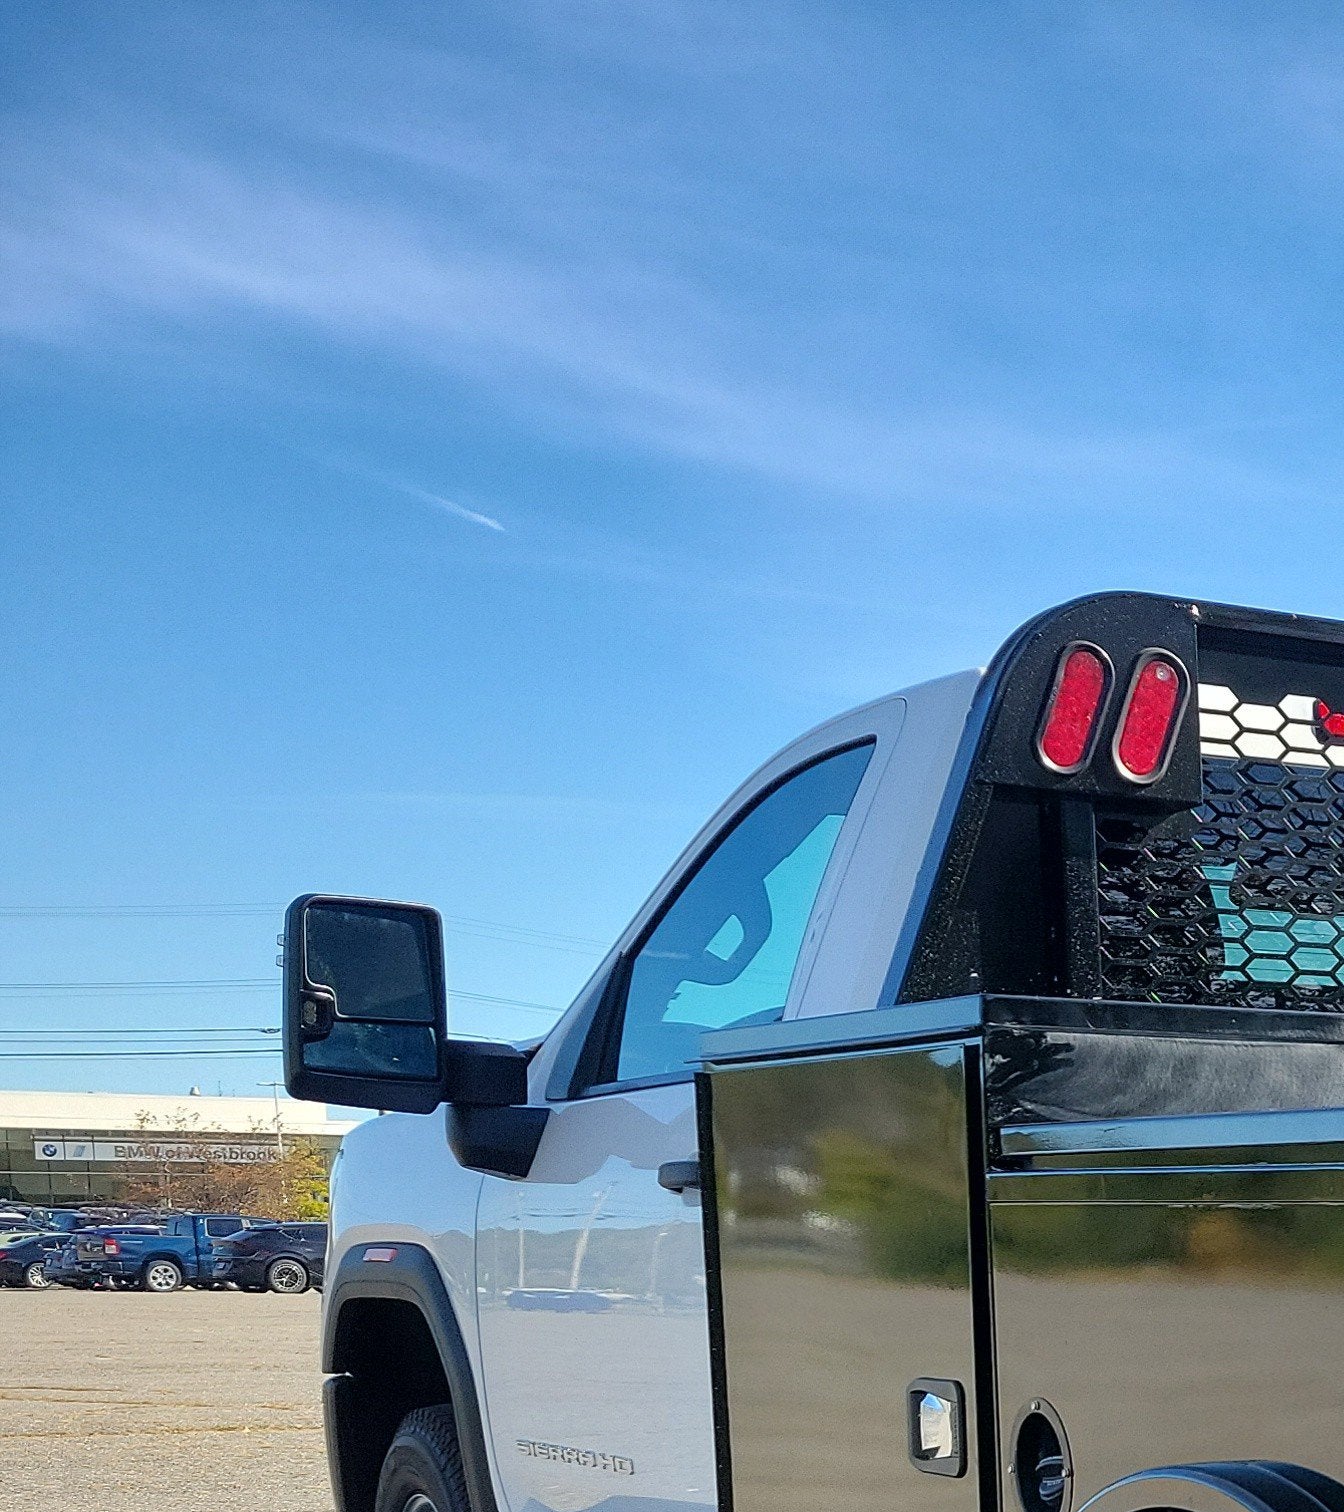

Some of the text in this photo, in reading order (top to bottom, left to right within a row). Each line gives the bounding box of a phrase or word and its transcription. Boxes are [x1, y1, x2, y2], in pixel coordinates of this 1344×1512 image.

[114, 1145, 161, 1160] BMW
[184, 1145, 277, 1162] Westbrook
[515, 1438, 635, 1475] SIERRA HD
